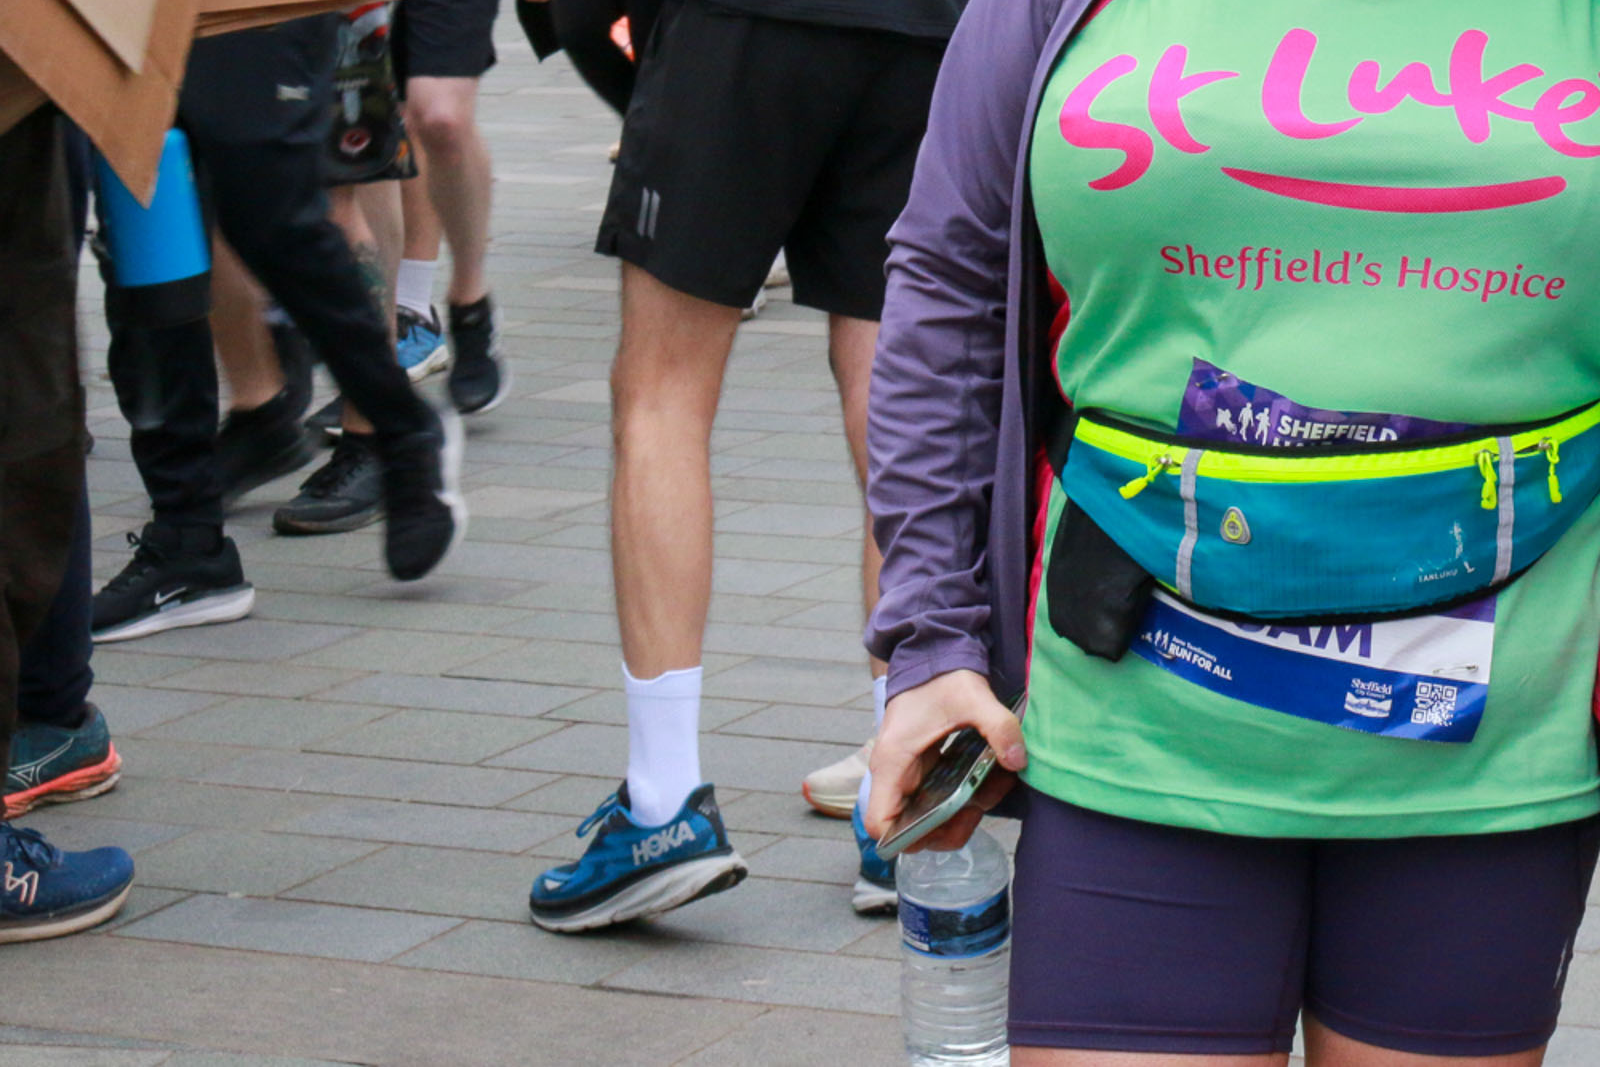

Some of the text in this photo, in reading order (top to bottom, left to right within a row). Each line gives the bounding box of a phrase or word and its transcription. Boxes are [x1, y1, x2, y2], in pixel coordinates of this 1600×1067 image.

[1058, 44, 1240, 191] St
[1160, 245, 1566, 302] Sheffield's Hospice
[1277, 414, 1398, 443] SHEFFIELD
[1168, 643, 1233, 681] RUN FOR ALL
[1351, 678, 1393, 695] Sheffield
[632, 819, 696, 866] HOKA
